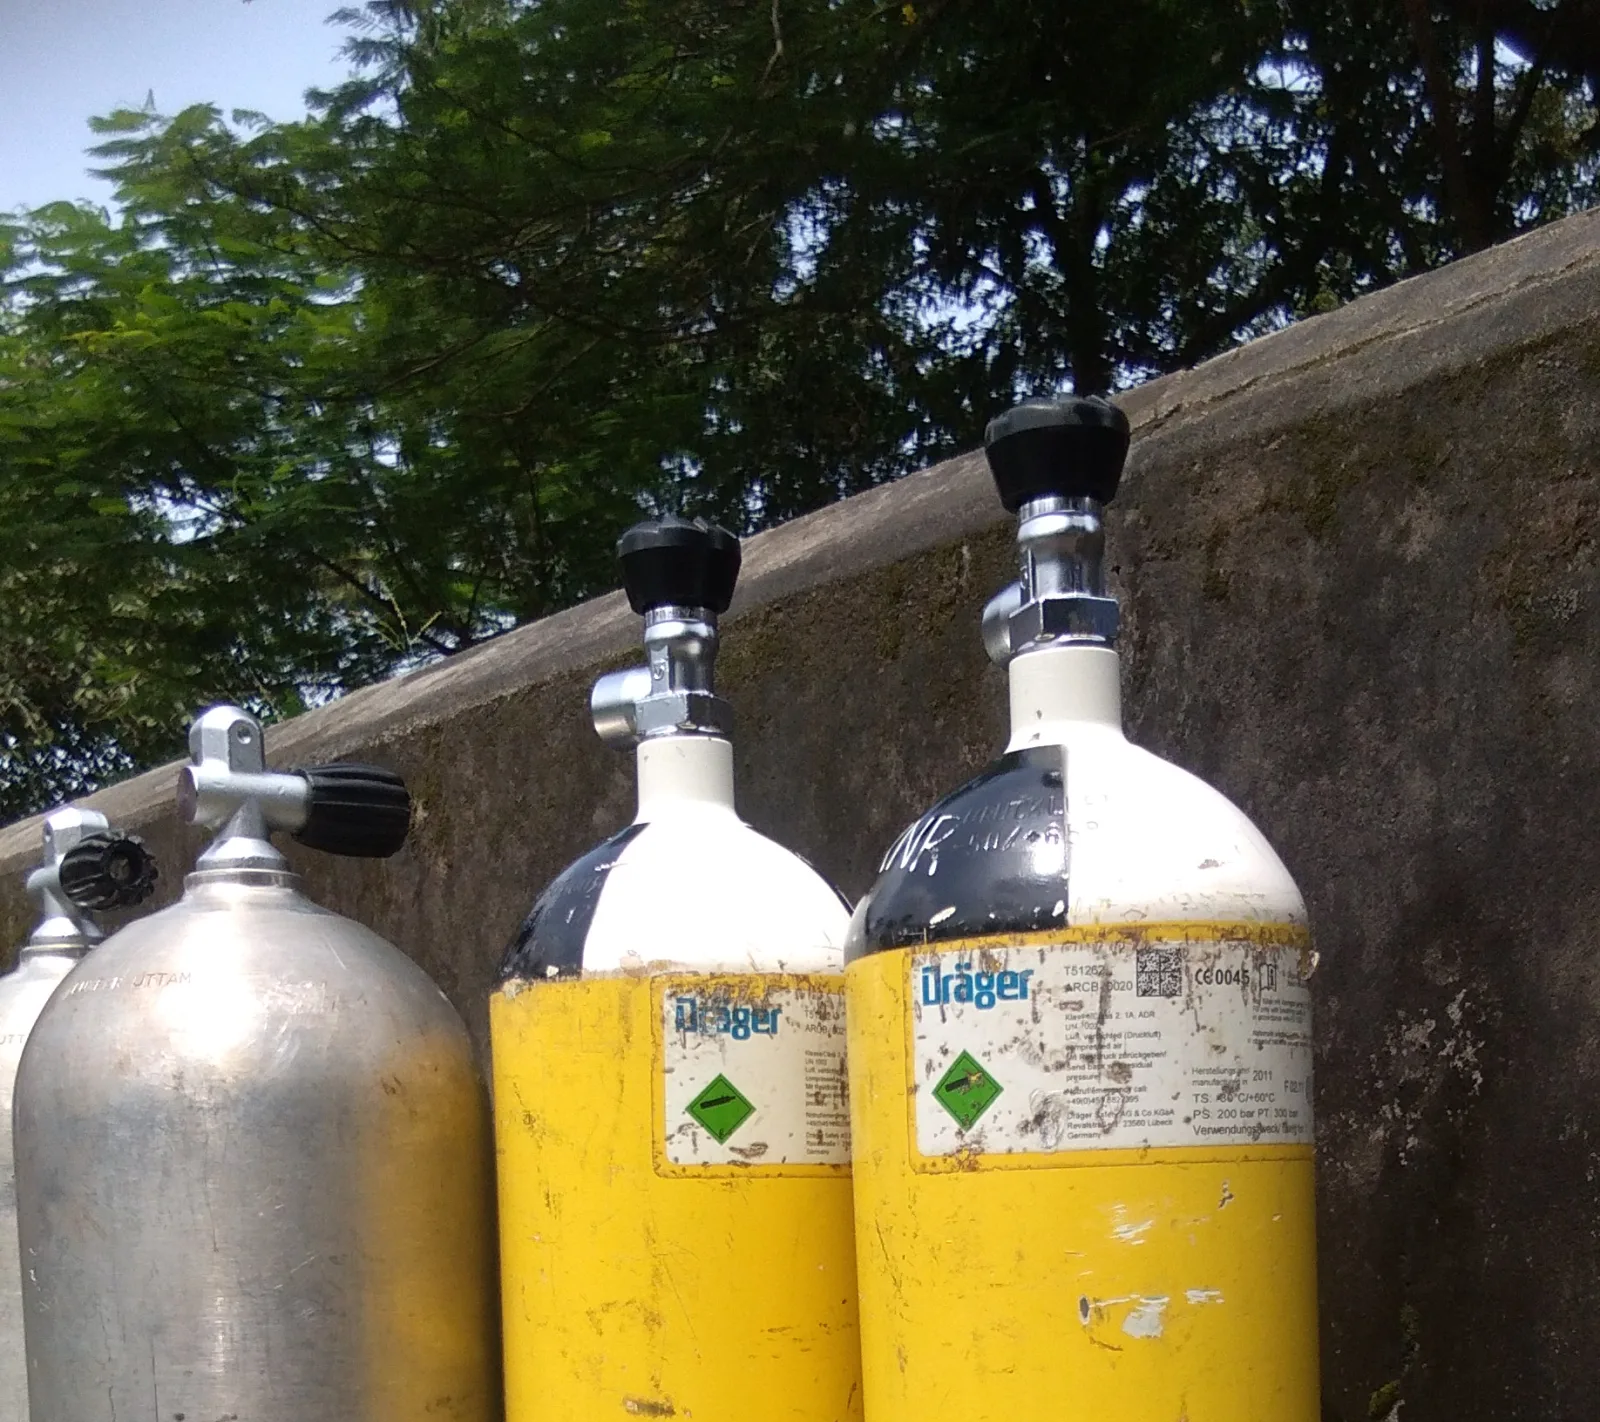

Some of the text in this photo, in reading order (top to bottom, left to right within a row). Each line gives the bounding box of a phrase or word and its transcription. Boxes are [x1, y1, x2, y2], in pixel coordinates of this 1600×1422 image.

[922, 962, 1034, 1010] Dräger
[1253, 1070, 1273, 1081] 2011
[1217, 1109, 1237, 1119] 200
[1240, 1109, 1255, 1118] bar
